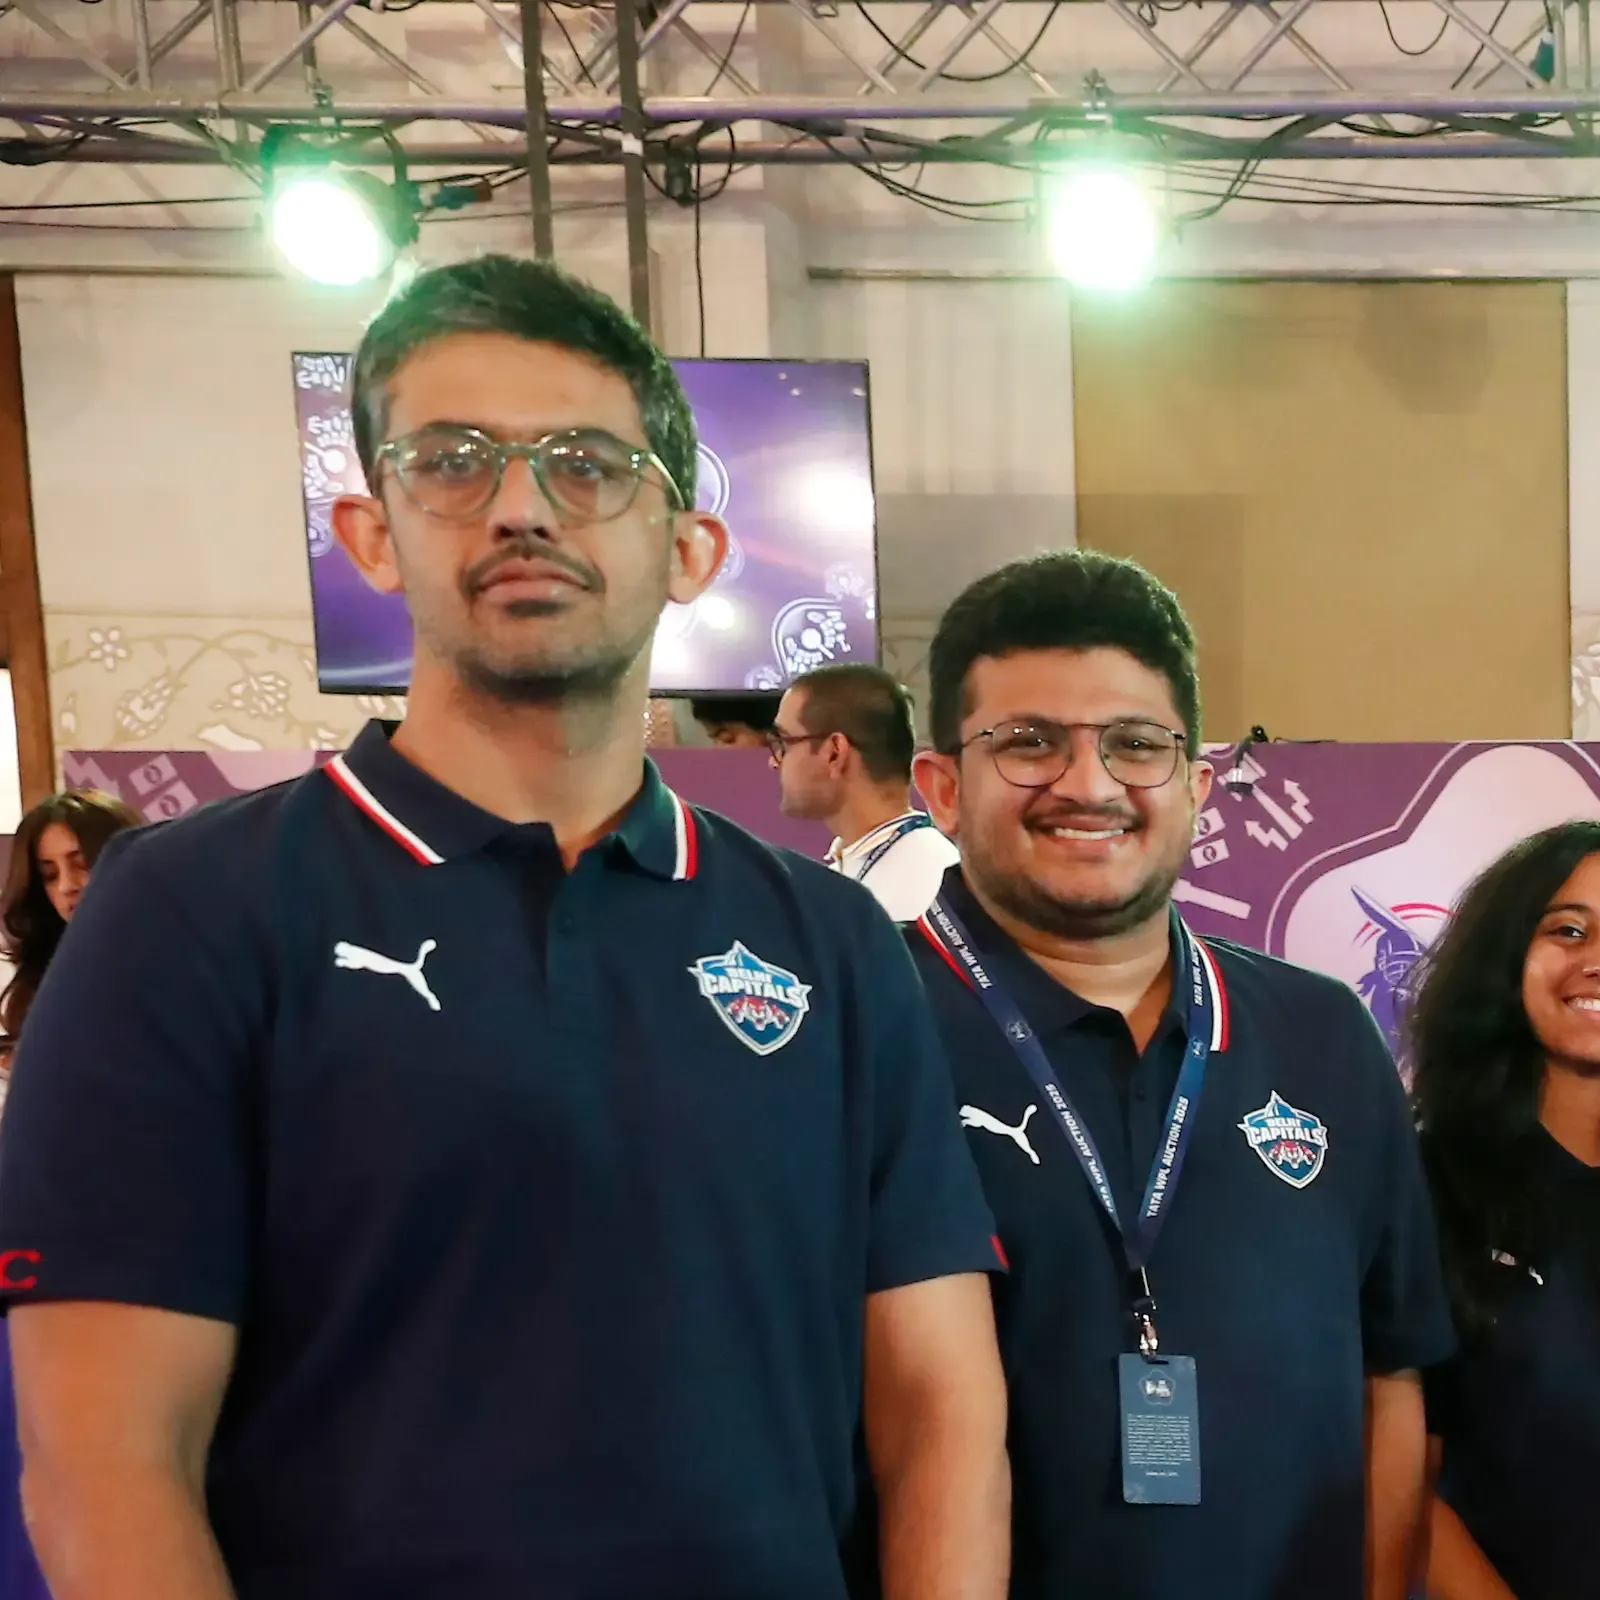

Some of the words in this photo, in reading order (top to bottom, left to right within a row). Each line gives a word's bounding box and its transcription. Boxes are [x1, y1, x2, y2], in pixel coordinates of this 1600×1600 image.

[936, 911, 965, 946] AUCTION
[959, 945, 977, 966] WPL
[702, 971, 805, 1009] CAPITALS
[971, 965, 993, 989] TATA
[1044, 1083, 1069, 1110] 2025
[1173, 1096, 1189, 1123] 2025
[1061, 1110, 1092, 1157] AUCTION
[1161, 1123, 1182, 1167] AUCTION
[1248, 1126, 1325, 1147] CAPITALS
[1088, 1158, 1103, 1184] WPL
[1154, 1168, 1170, 1190] WPL
[1146, 1192, 1164, 1217] TATA
